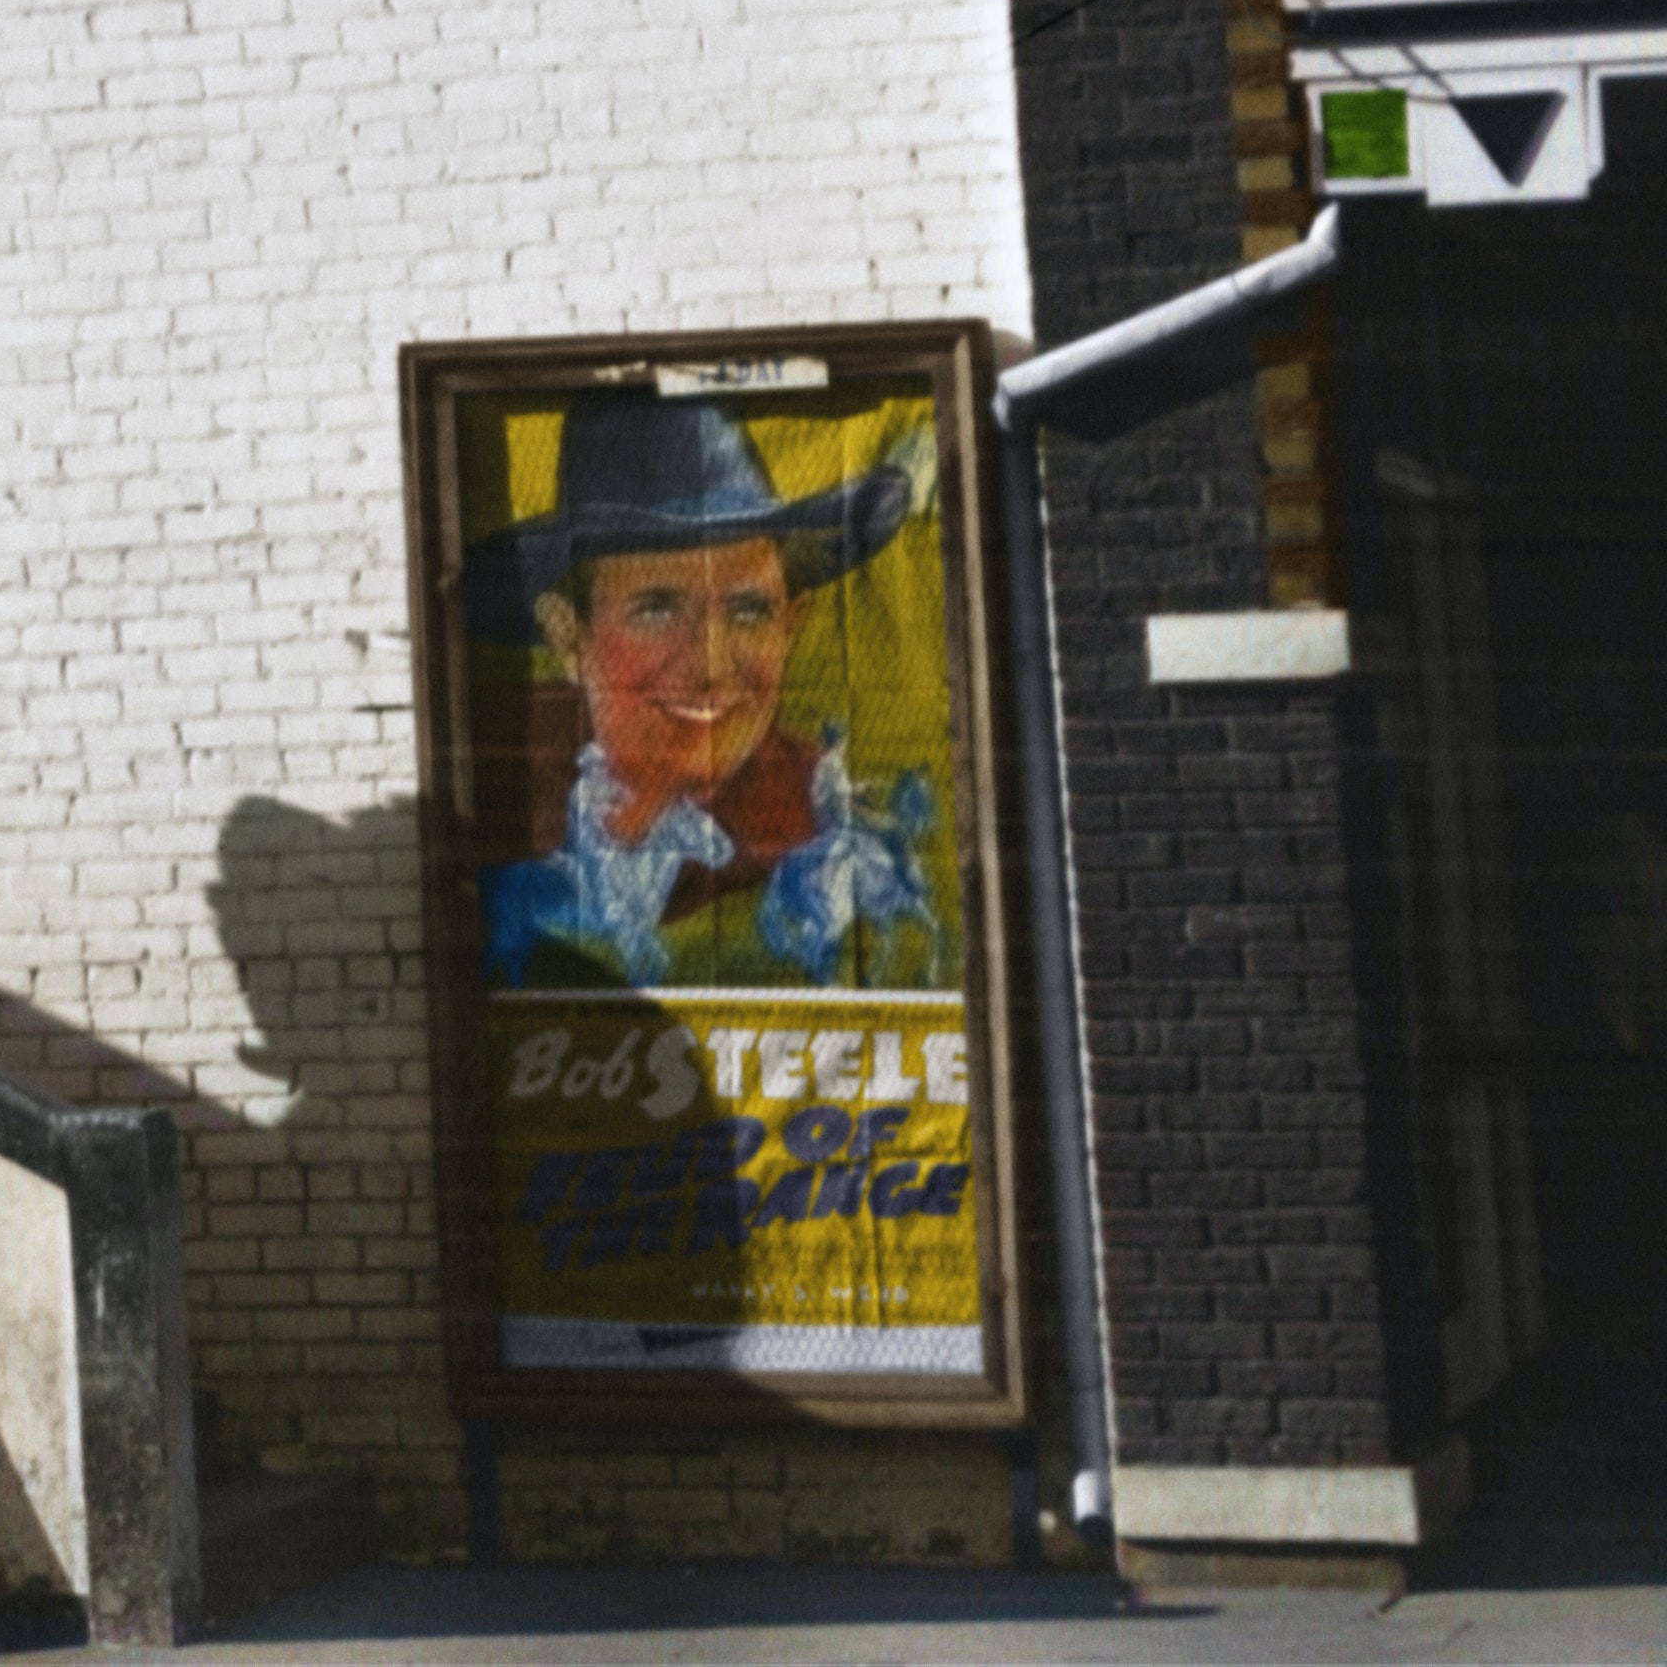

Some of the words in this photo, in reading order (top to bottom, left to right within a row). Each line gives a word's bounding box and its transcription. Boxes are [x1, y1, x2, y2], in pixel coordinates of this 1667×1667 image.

[508, 1028, 640, 1100] Bob
[638, 1026, 968, 1120] STEELE
[516, 1116, 766, 1223] FEUD
[784, 1107, 910, 1162] OF
[539, 1203, 680, 1272] THE
[686, 1163, 969, 1254] RANGE
